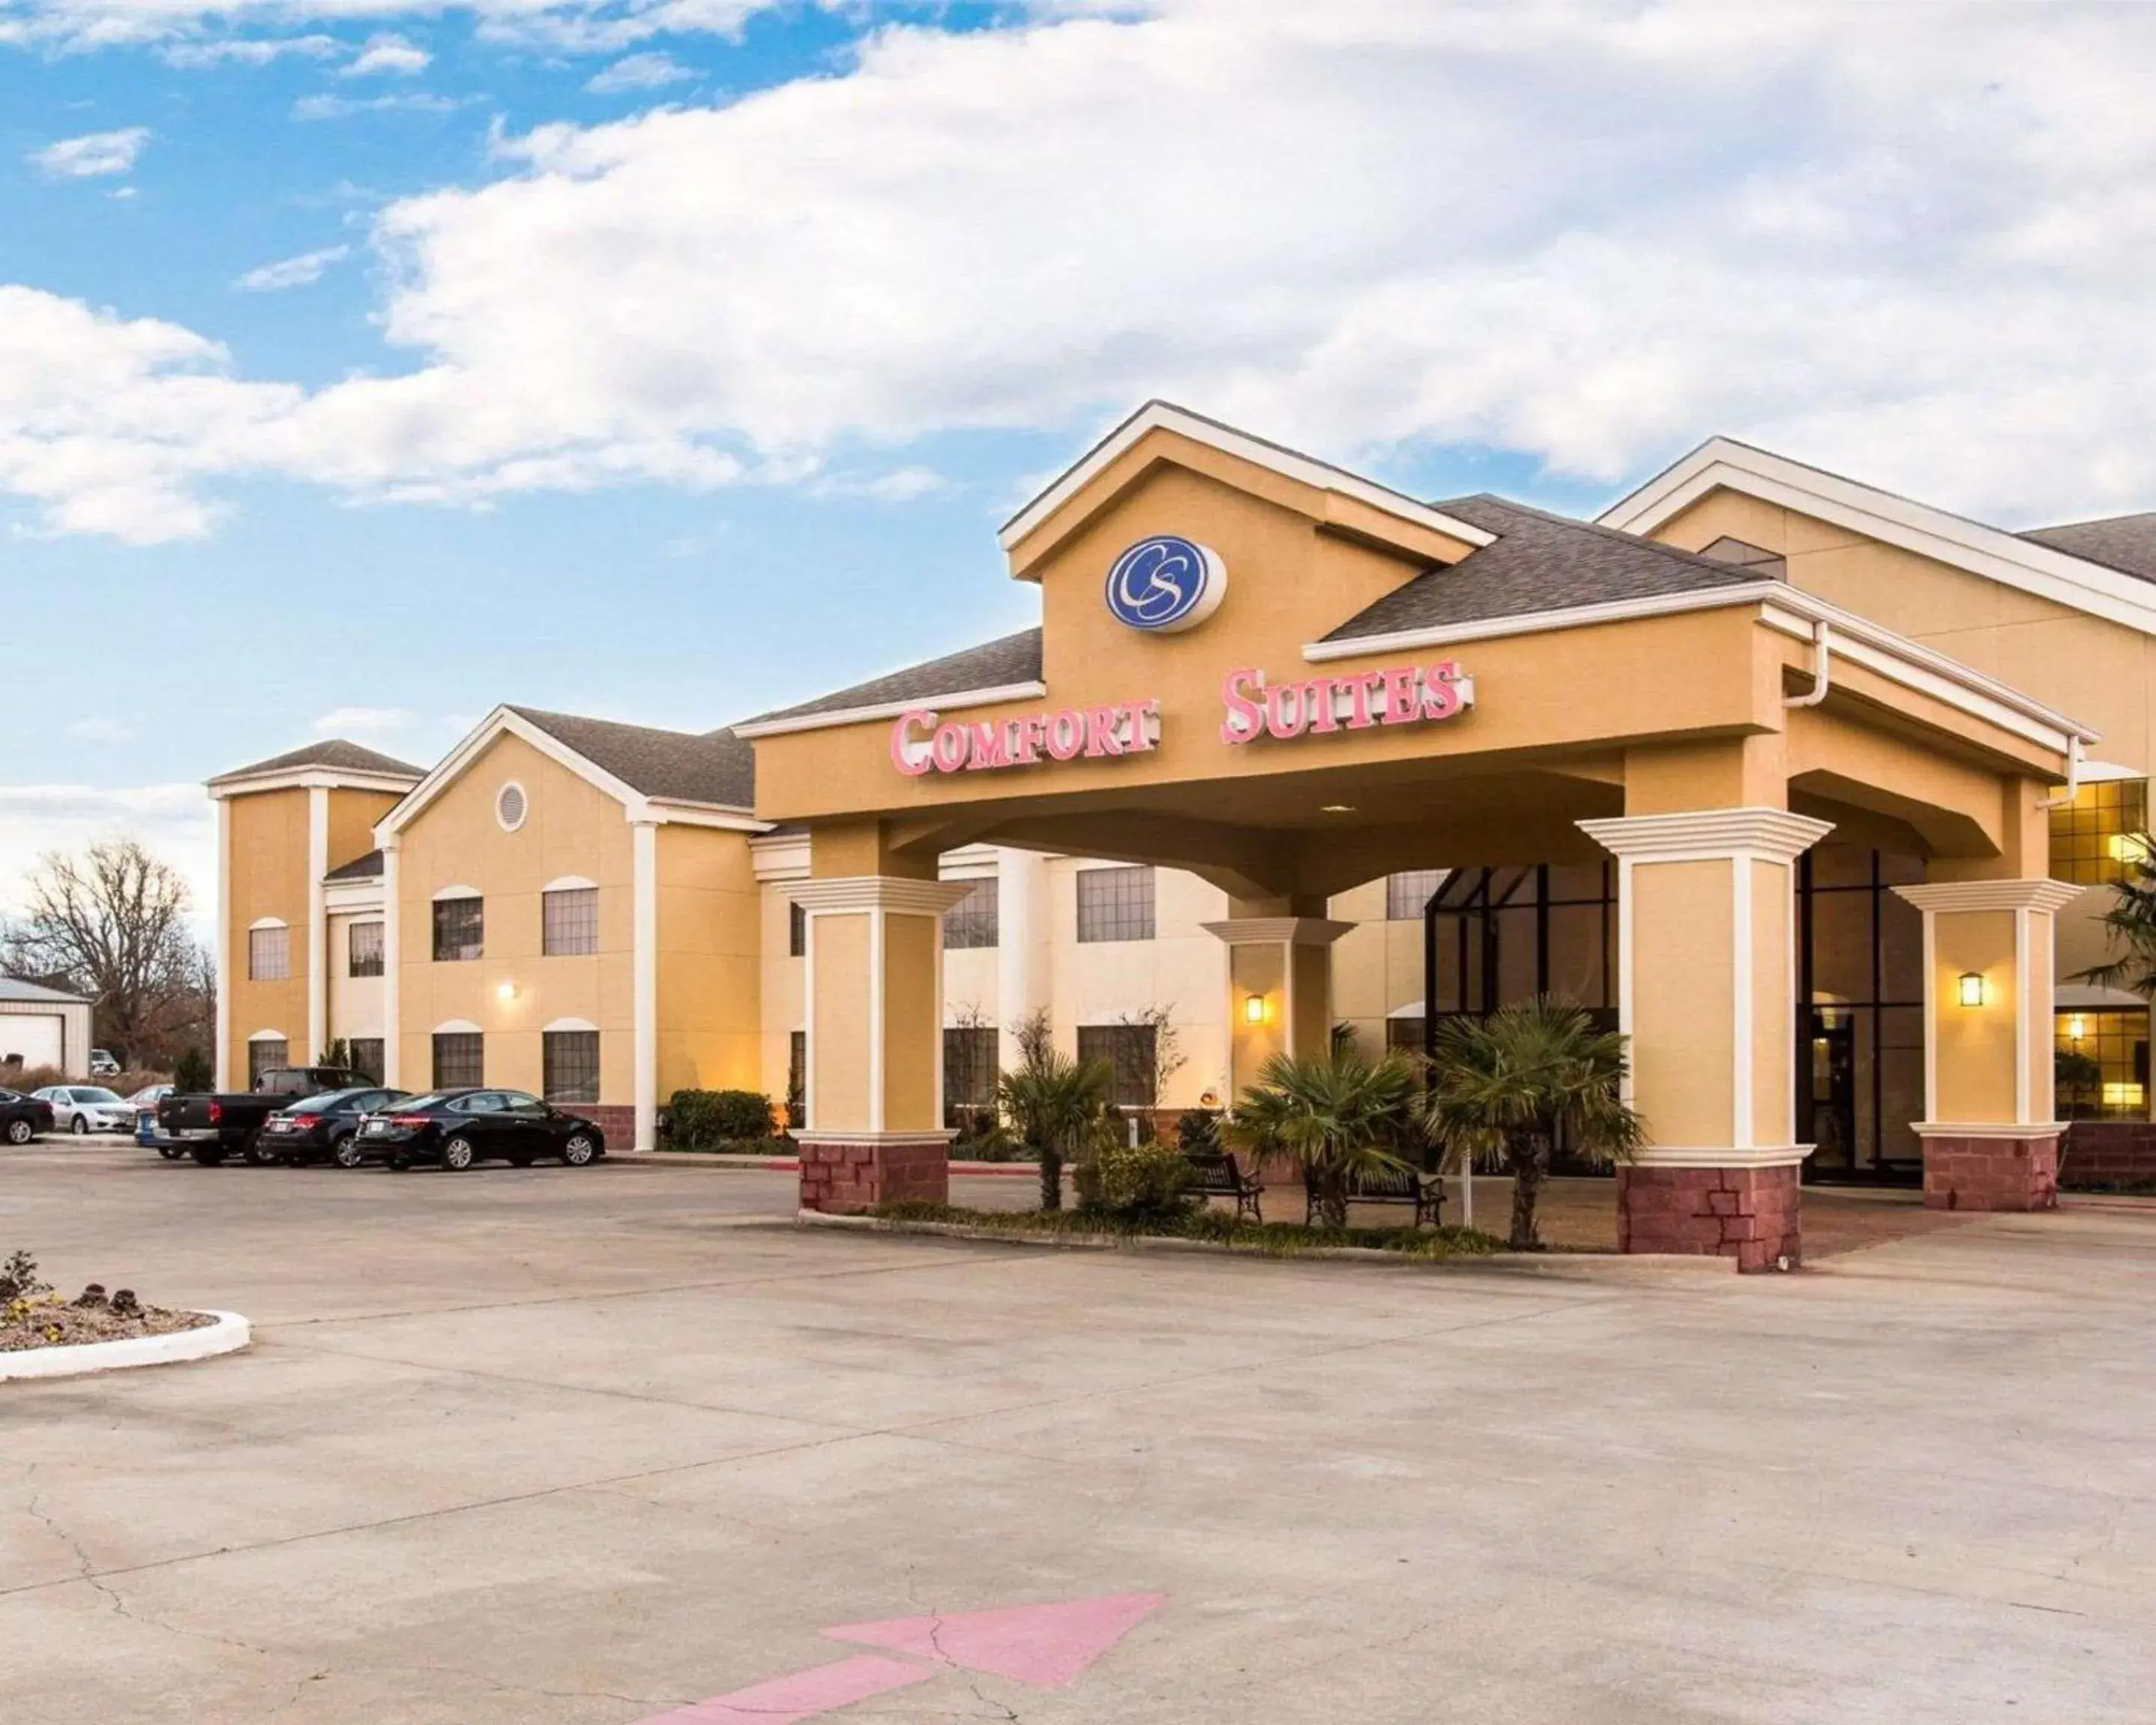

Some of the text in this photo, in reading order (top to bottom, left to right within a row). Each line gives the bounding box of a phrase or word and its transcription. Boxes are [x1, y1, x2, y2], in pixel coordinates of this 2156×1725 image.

[1120, 544, 1189, 620] CS
[891, 662, 1473, 776] COMFORT SUITES
